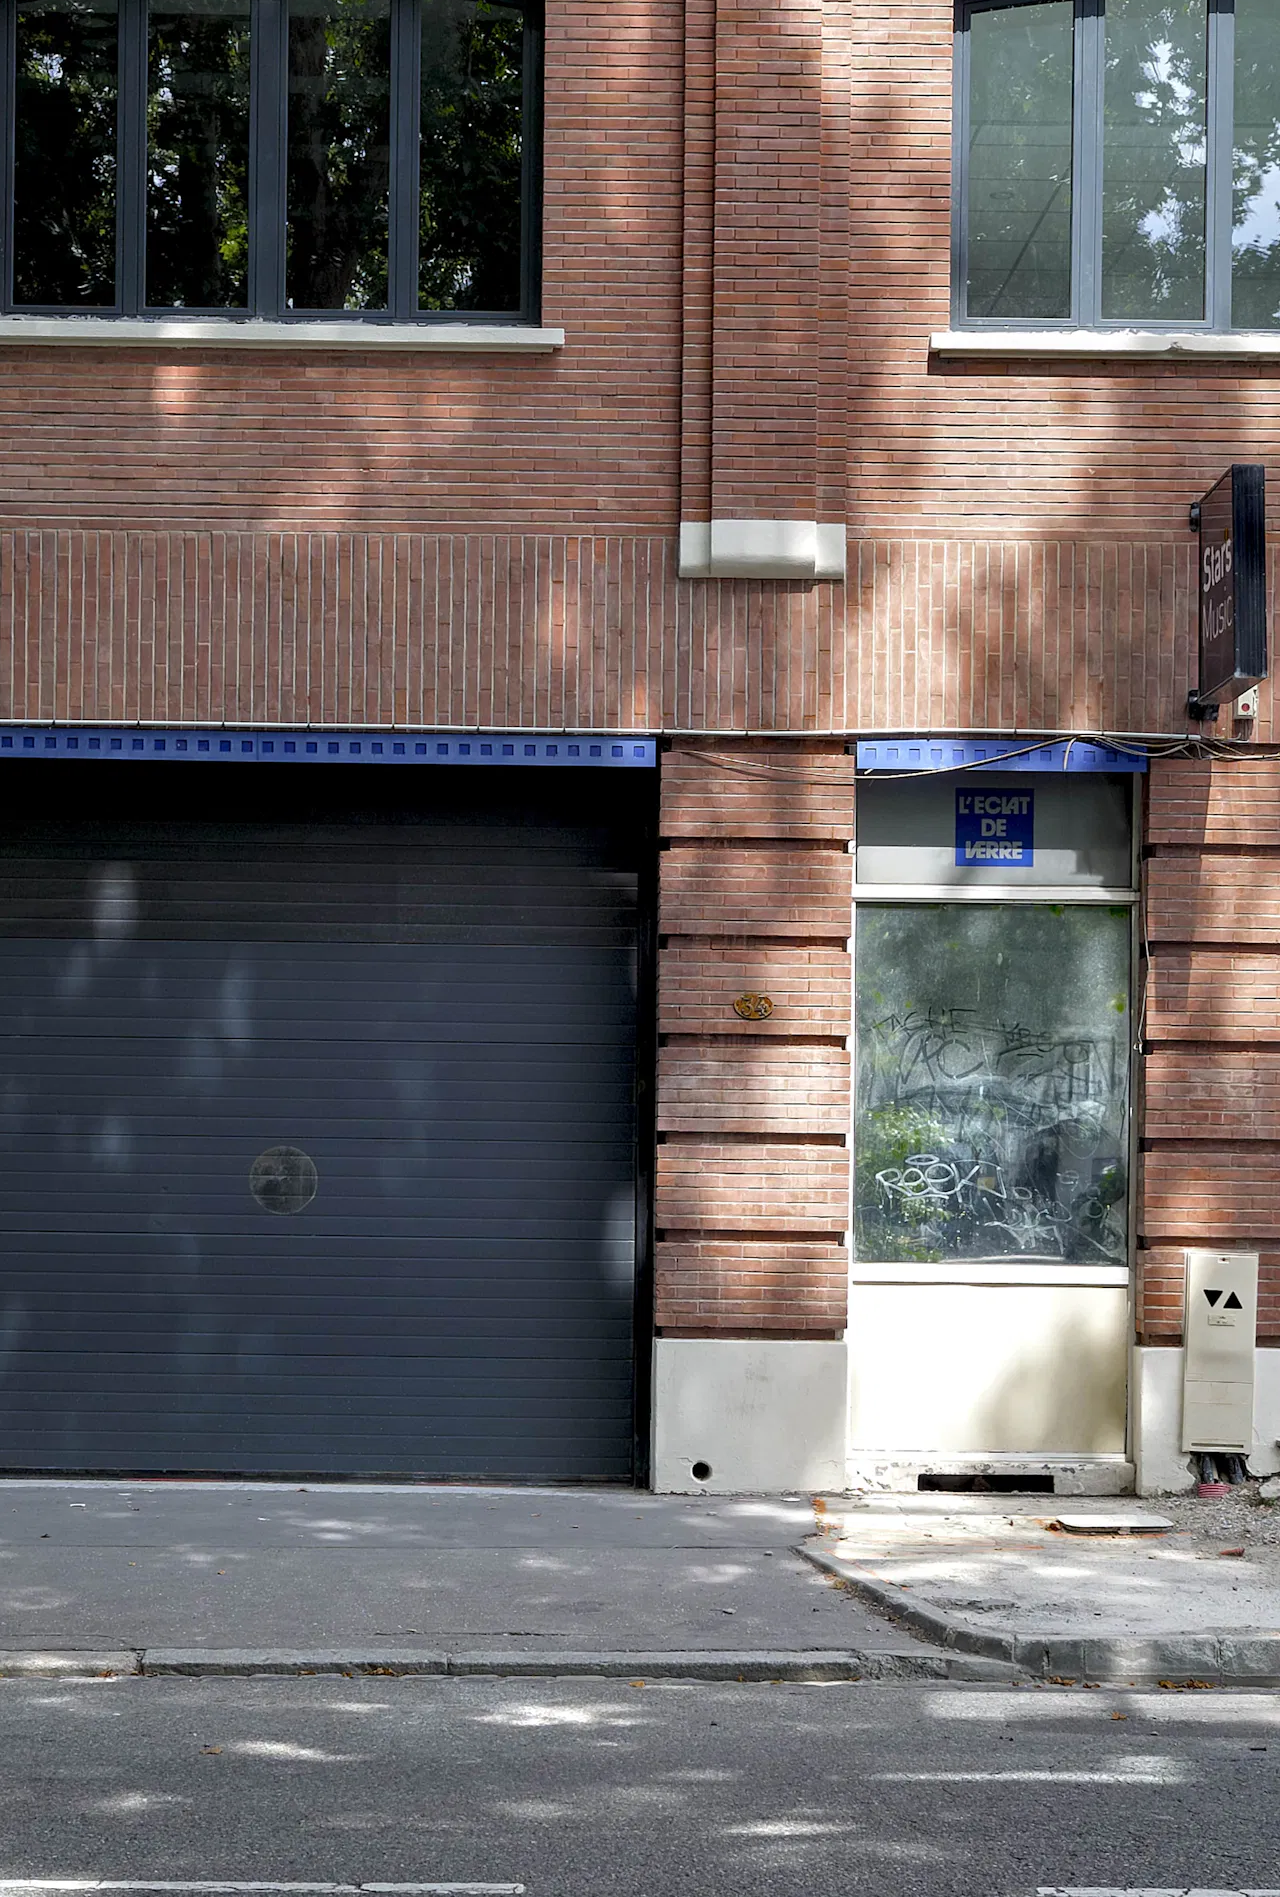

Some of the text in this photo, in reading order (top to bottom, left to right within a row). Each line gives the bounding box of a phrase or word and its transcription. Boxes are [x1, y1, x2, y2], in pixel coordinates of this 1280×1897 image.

[1203, 586, 1232, 645] Music
[981, 818, 1007, 837] DE
[965, 841, 1023, 859] VERRE
[740, 994, 768, 1017] 34
